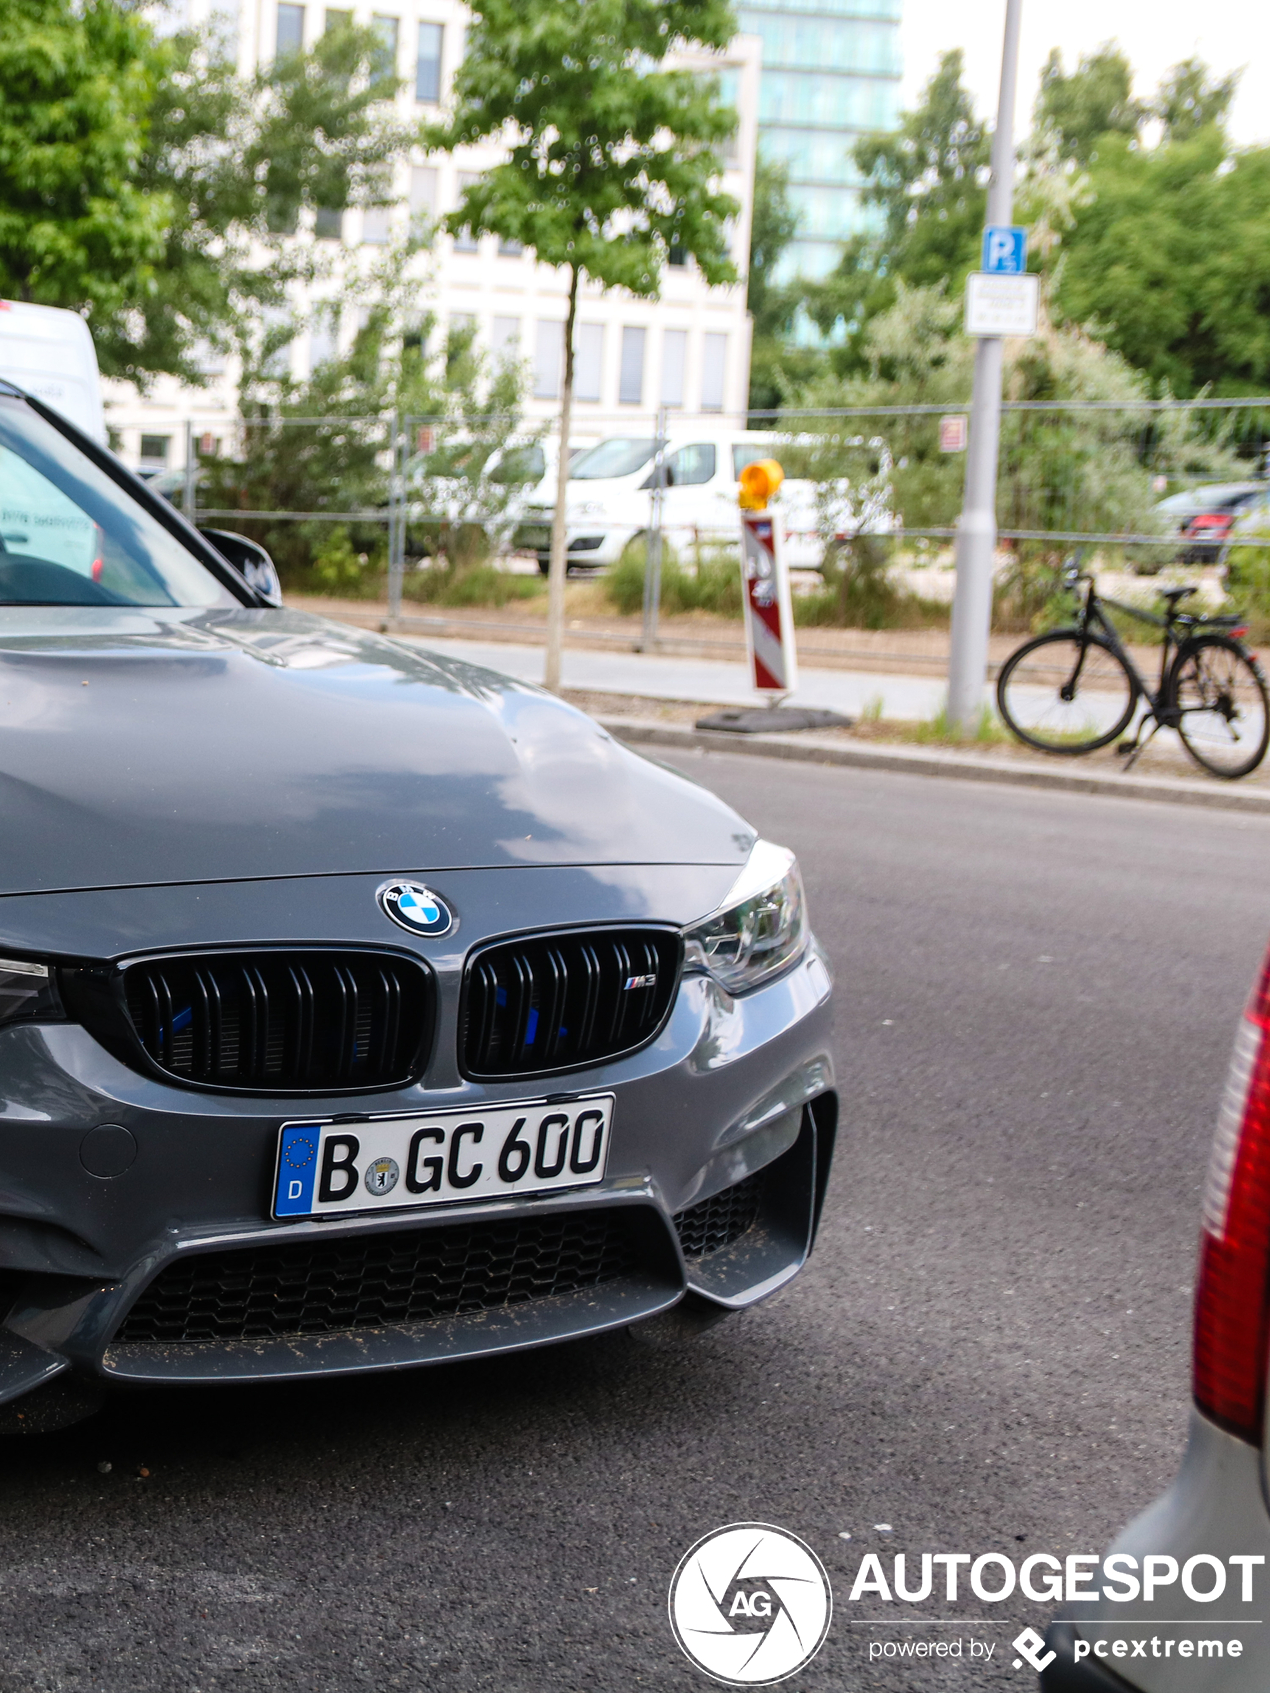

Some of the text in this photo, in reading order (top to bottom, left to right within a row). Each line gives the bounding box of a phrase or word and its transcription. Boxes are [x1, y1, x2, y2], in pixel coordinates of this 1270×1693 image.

[989, 231, 1015, 269] P
[386, 885, 437, 902] BMW
[631, 974, 656, 988] M3
[318, 1109, 605, 1203] B GC 600
[287, 1180, 303, 1200] D
